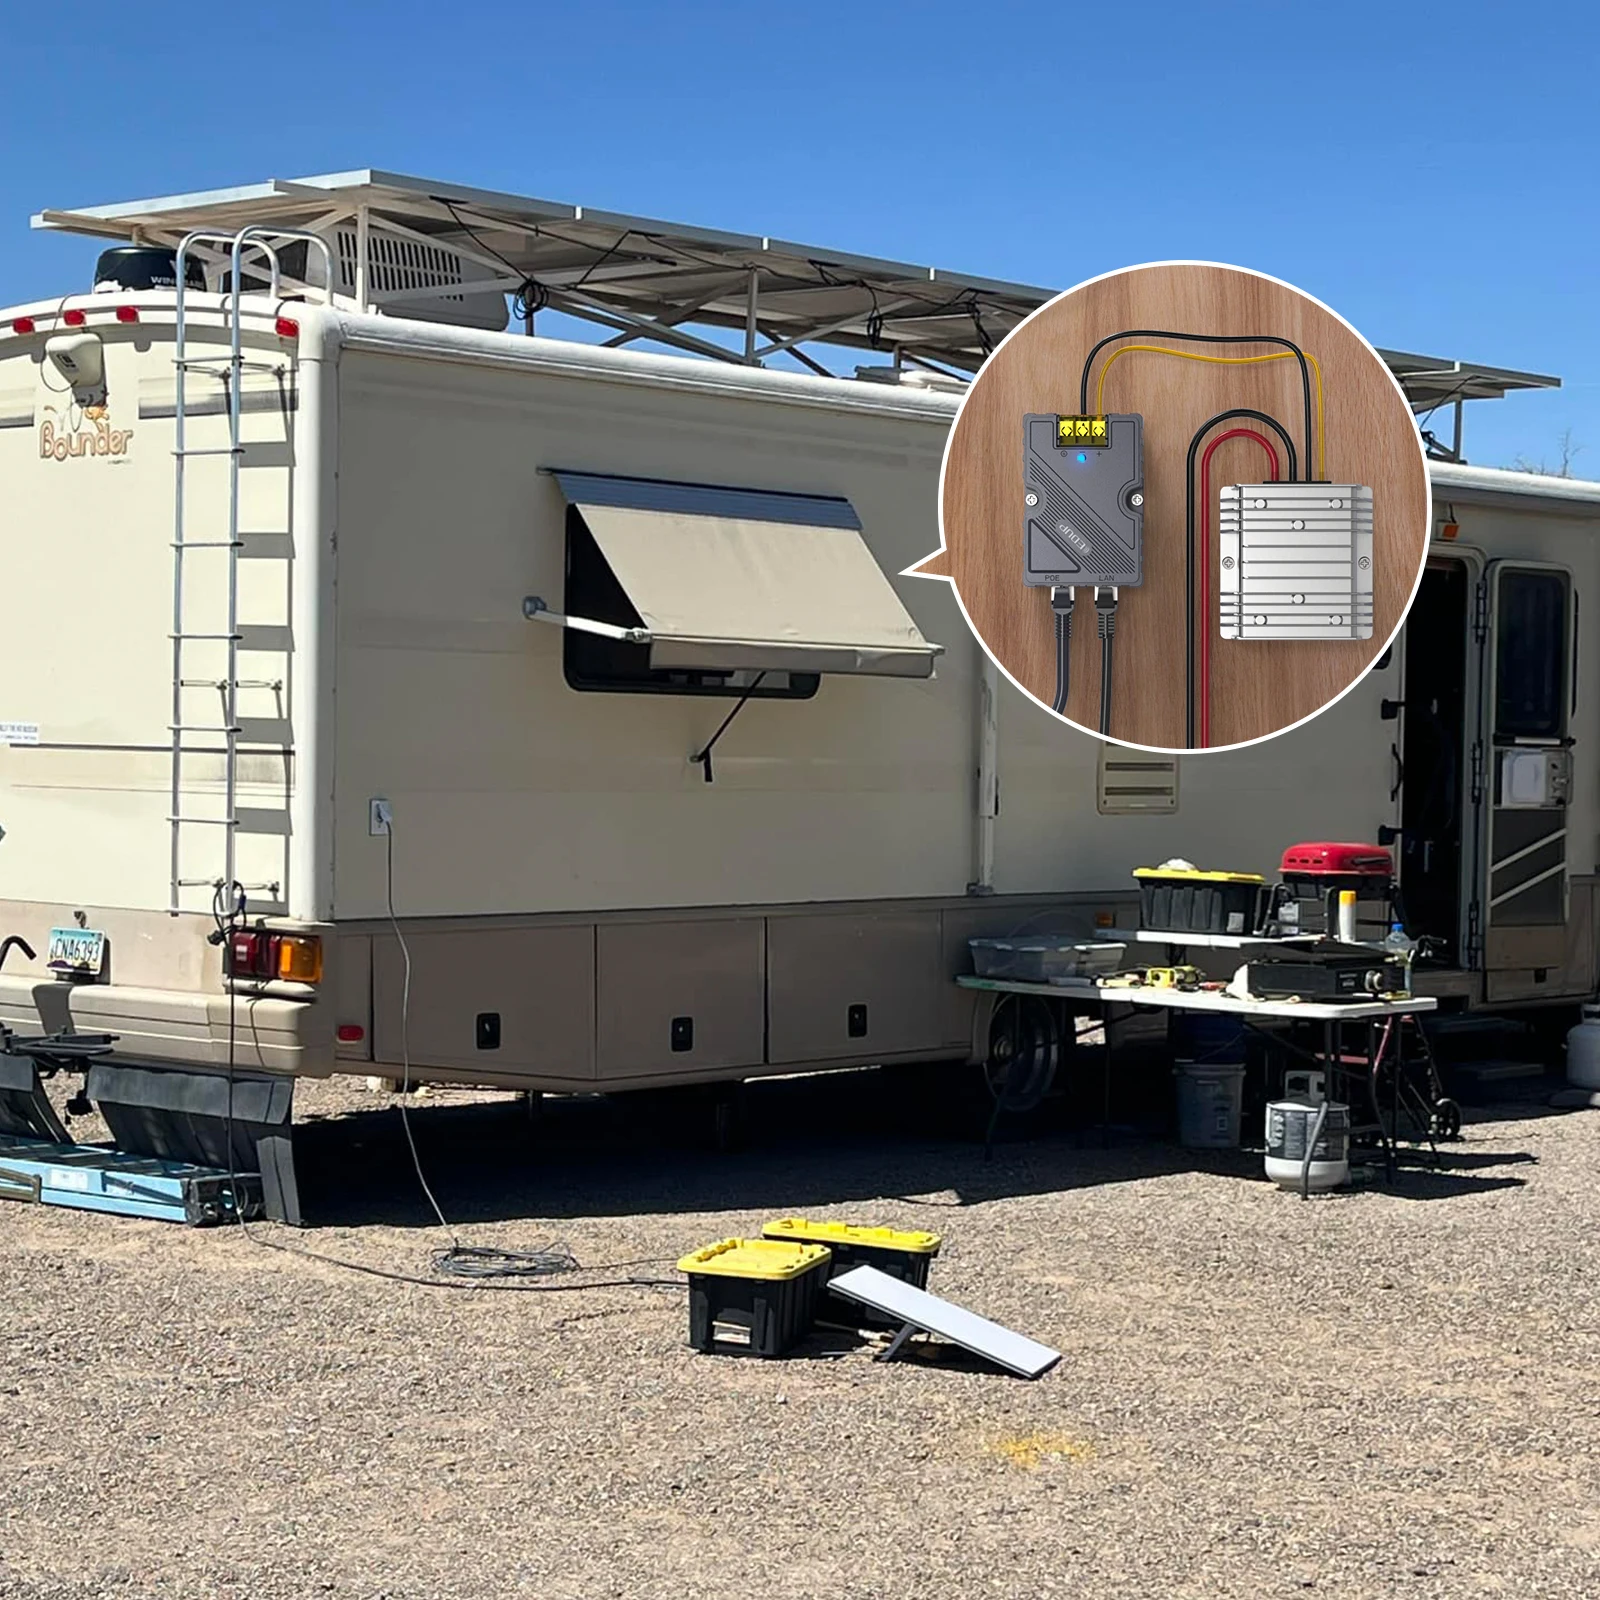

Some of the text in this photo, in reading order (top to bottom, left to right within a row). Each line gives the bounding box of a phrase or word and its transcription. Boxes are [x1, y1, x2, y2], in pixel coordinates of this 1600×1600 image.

[40, 420, 133, 462] Bounder
[1059, 524, 1086, 550] EDUP
[1044, 574, 1060, 582] POE
[1098, 574, 1115, 582] LAN
[54, 938, 100, 962] CNA6393
